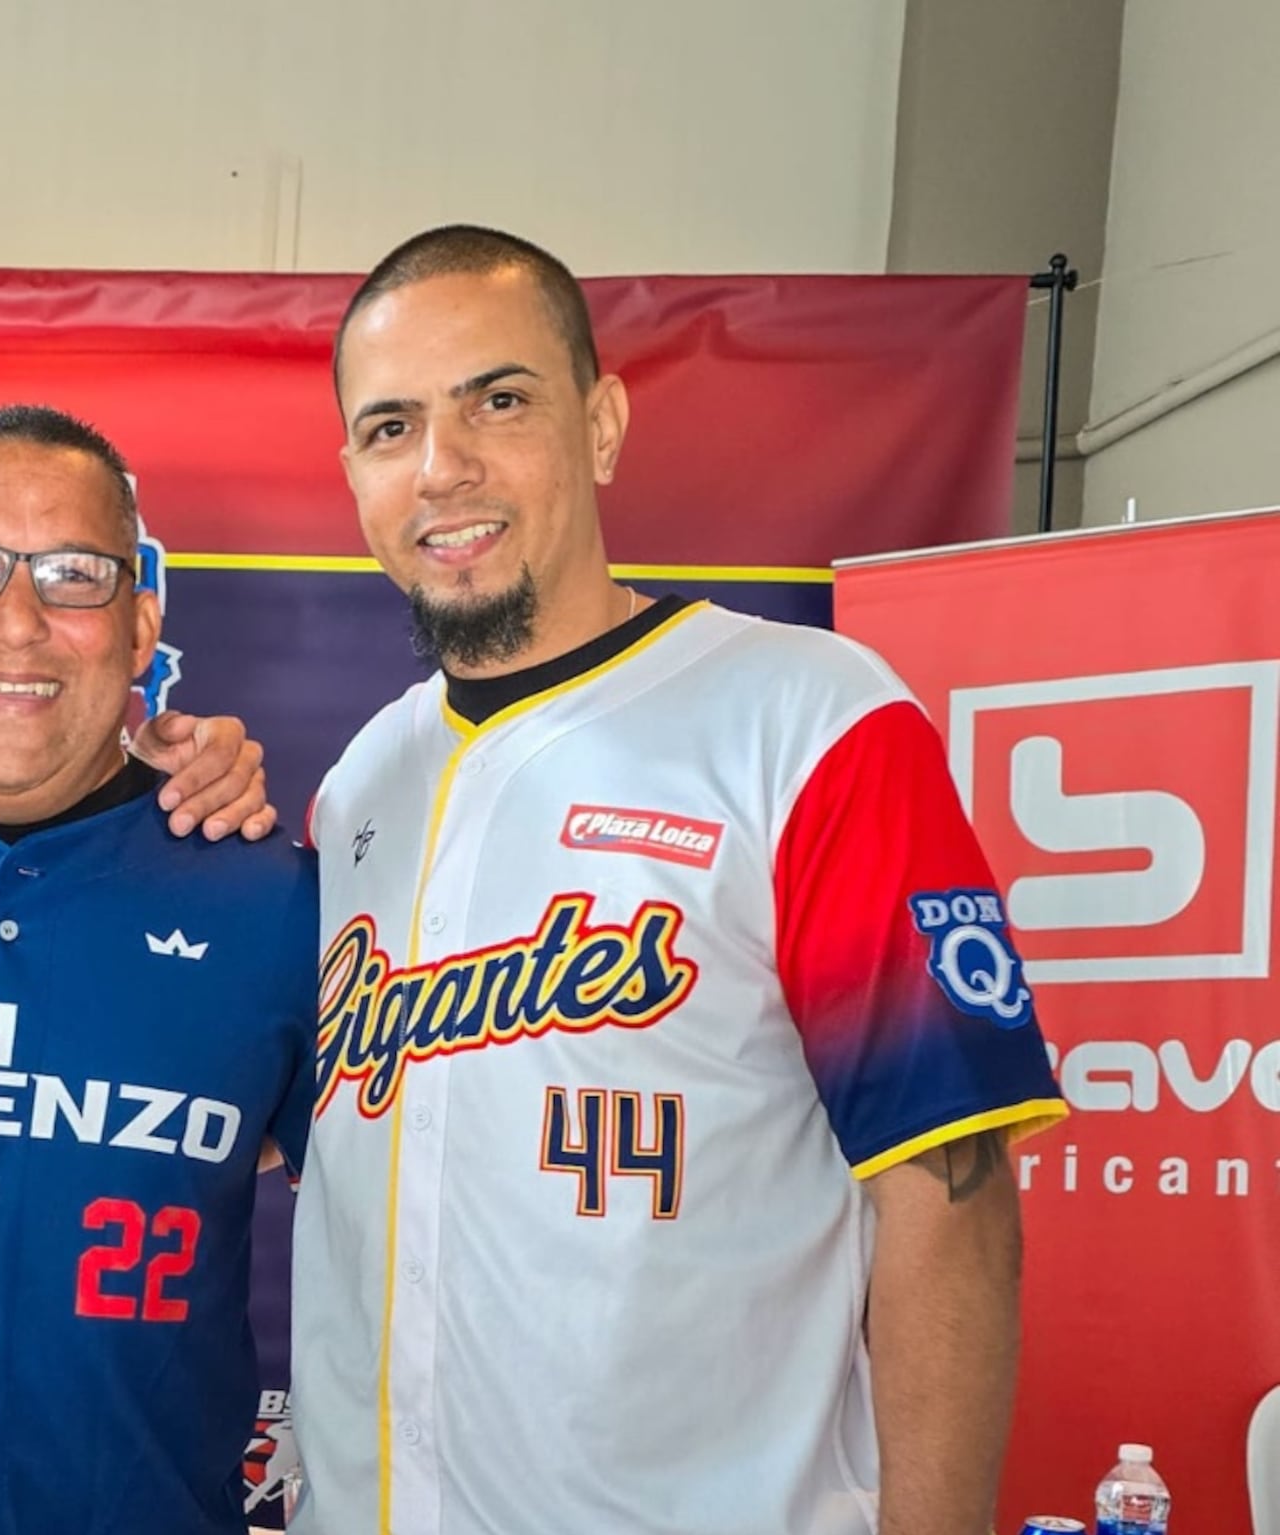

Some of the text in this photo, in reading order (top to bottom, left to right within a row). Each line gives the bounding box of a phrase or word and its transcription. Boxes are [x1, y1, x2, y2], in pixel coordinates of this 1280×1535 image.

[585, 812, 652, 839] Plaza
[917, 894, 1004, 928] DON
[316, 892, 699, 1118] Gigantes
[936, 924, 1031, 1018] Q
[539, 1085, 685, 1220] 44
[75, 1196, 202, 1323] 22
